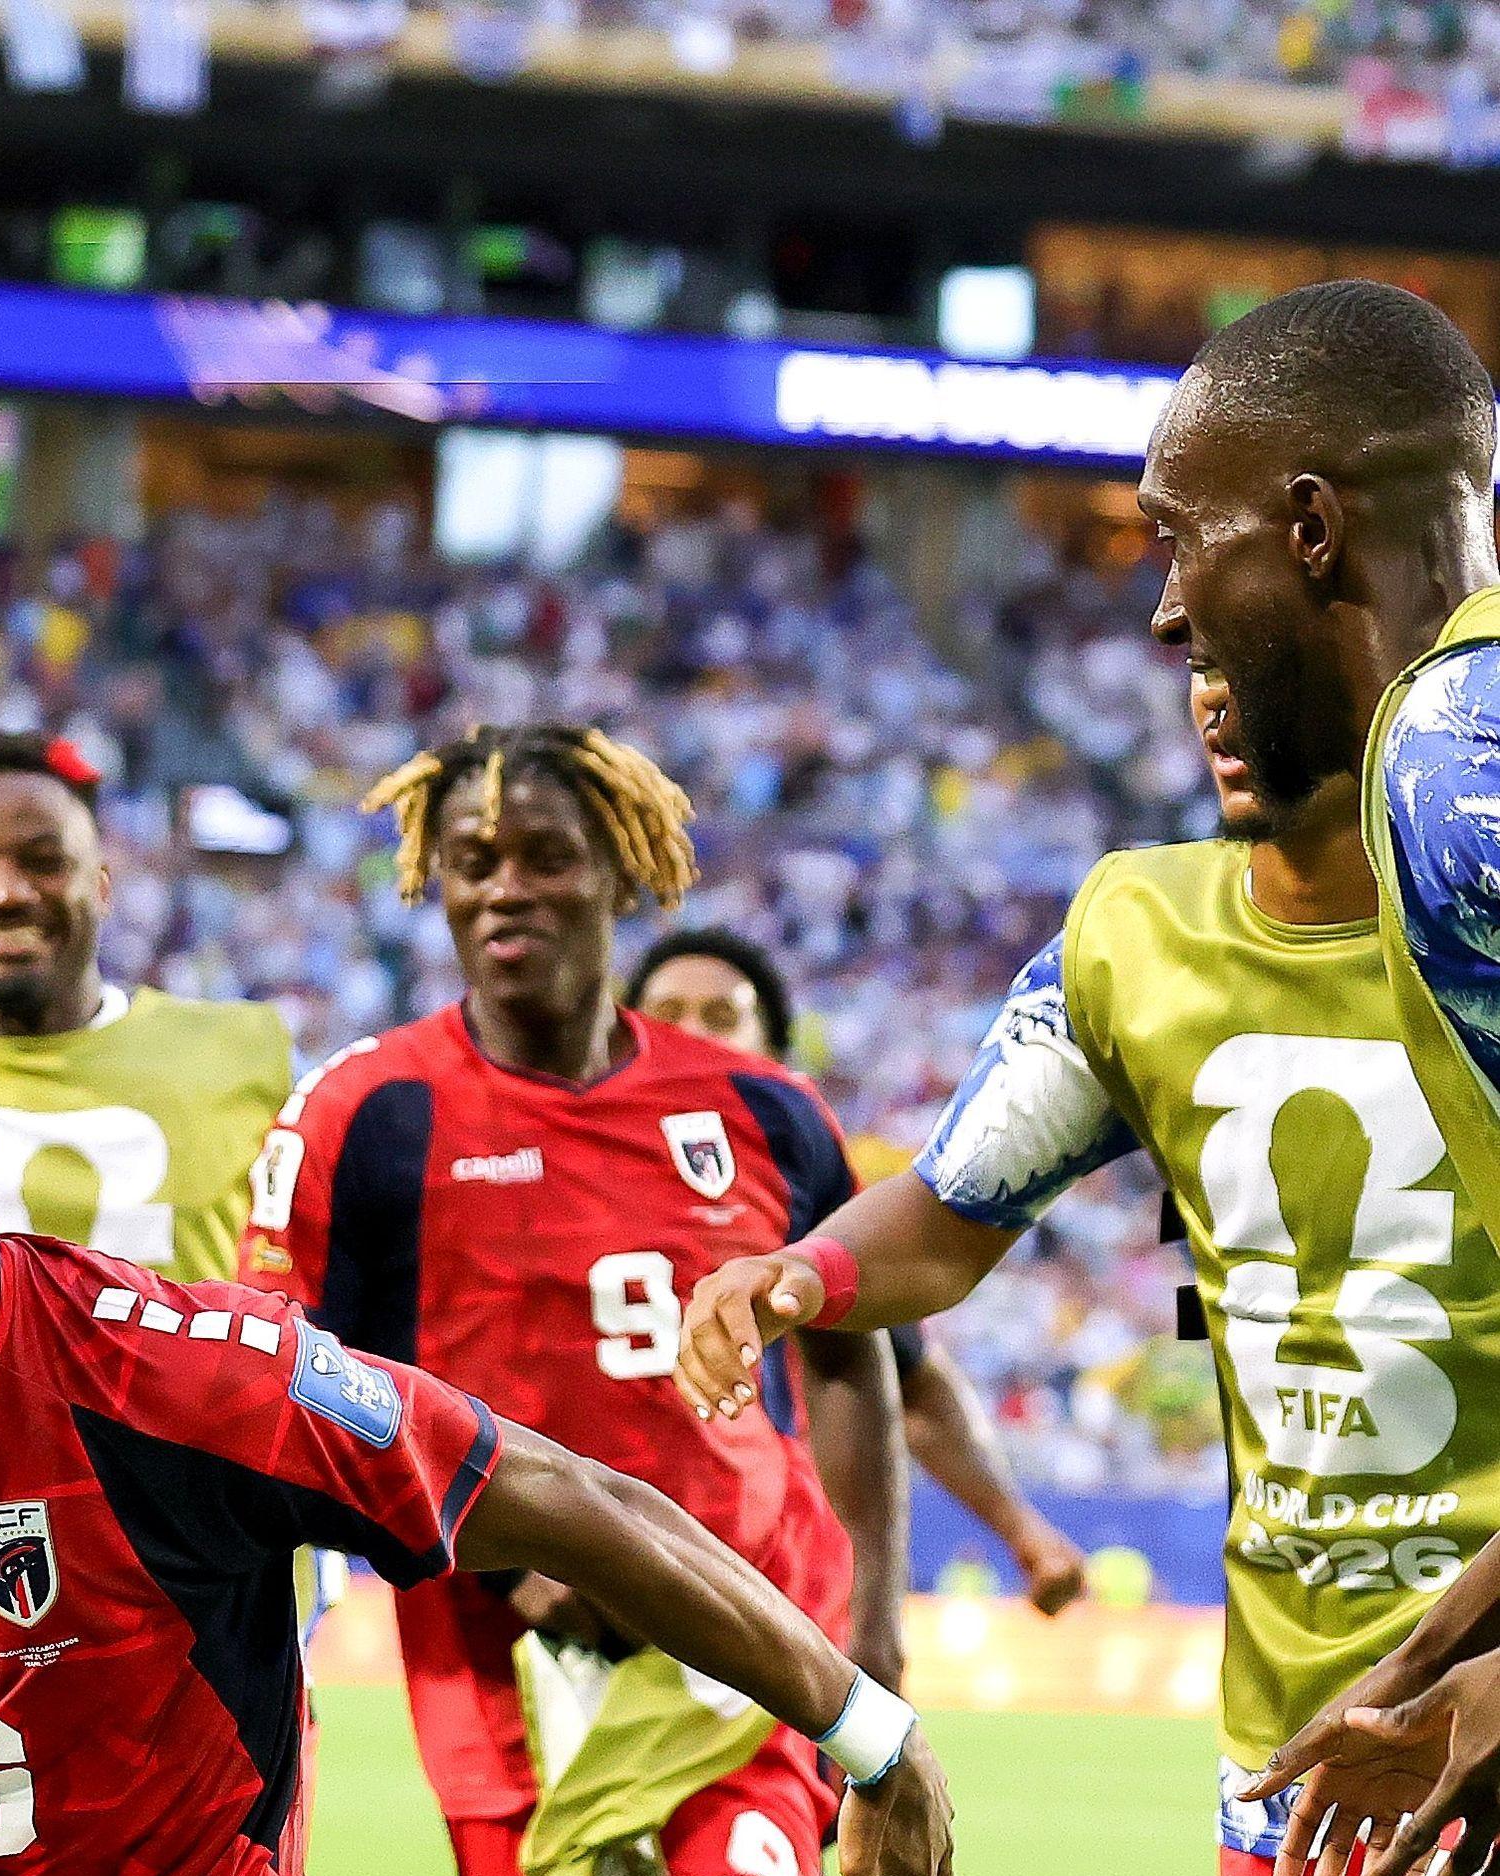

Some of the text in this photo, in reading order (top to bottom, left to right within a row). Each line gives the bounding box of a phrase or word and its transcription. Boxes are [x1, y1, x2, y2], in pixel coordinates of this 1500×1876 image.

[588, 1251, 681, 1379] 9
[1274, 1386, 1380, 1438] FIFA
[1362, 1491, 1461, 1529] CUP
[1238, 1520, 1463, 1593] 2026
